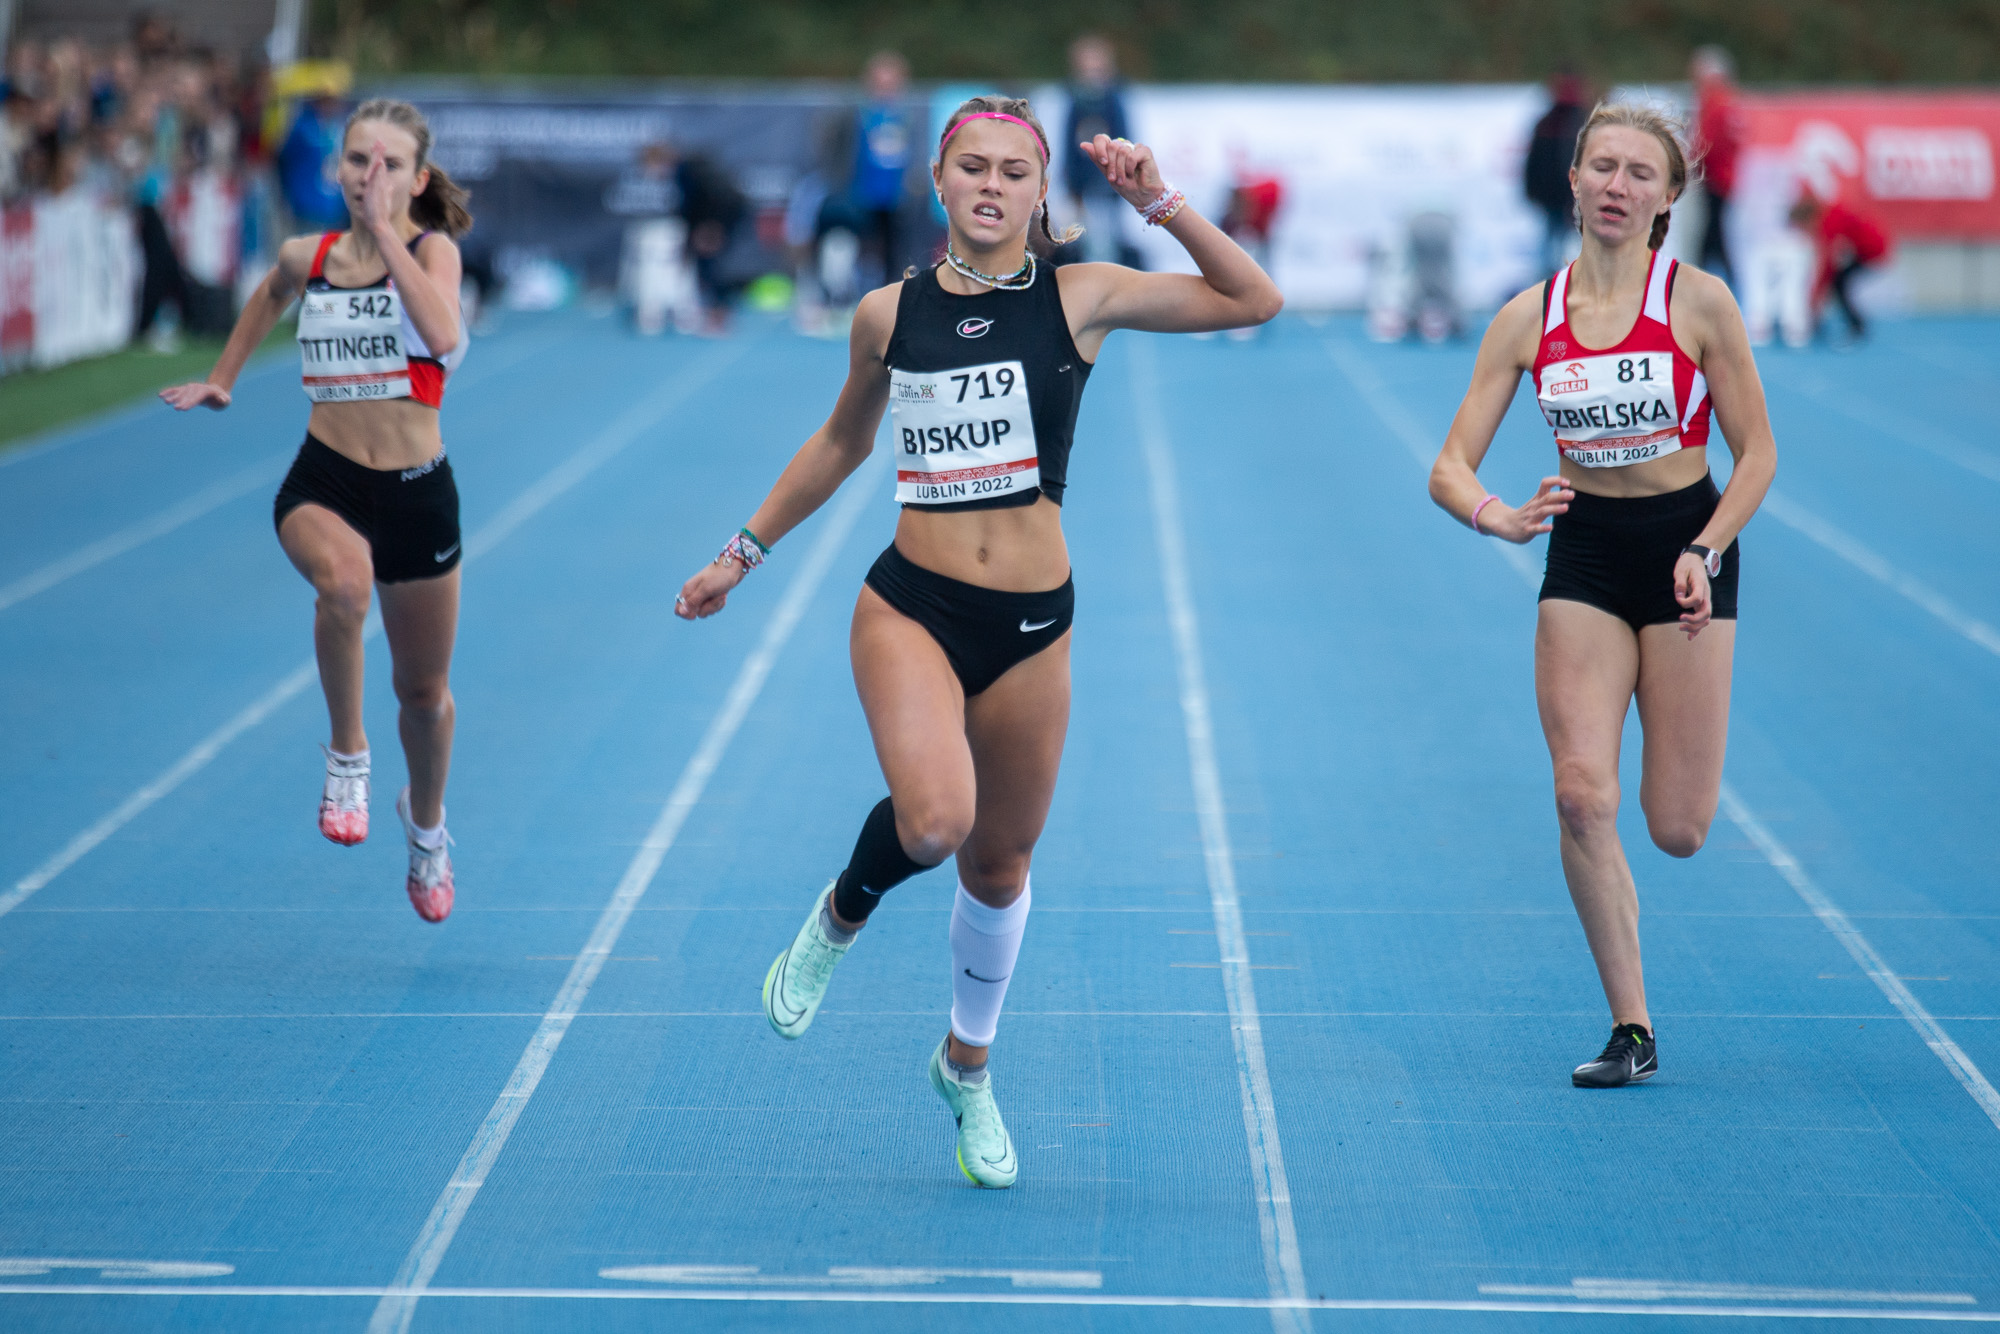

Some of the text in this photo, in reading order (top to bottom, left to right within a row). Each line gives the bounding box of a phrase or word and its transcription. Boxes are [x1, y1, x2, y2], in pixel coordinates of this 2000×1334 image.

[348, 295, 393, 319] 542
[1617, 358, 1653, 383] 81
[315, 384, 389, 399] LUBLIN 2022
[950, 368, 1015, 404] 719
[1551, 380, 1587, 395] ORLEN
[1548, 399, 1671, 429] ZBIELSKA
[902, 419, 1011, 455] BISKUP
[1571, 445, 1658, 463] LUBLIN 2022
[916, 476, 1013, 498] LUBLIN 2022
